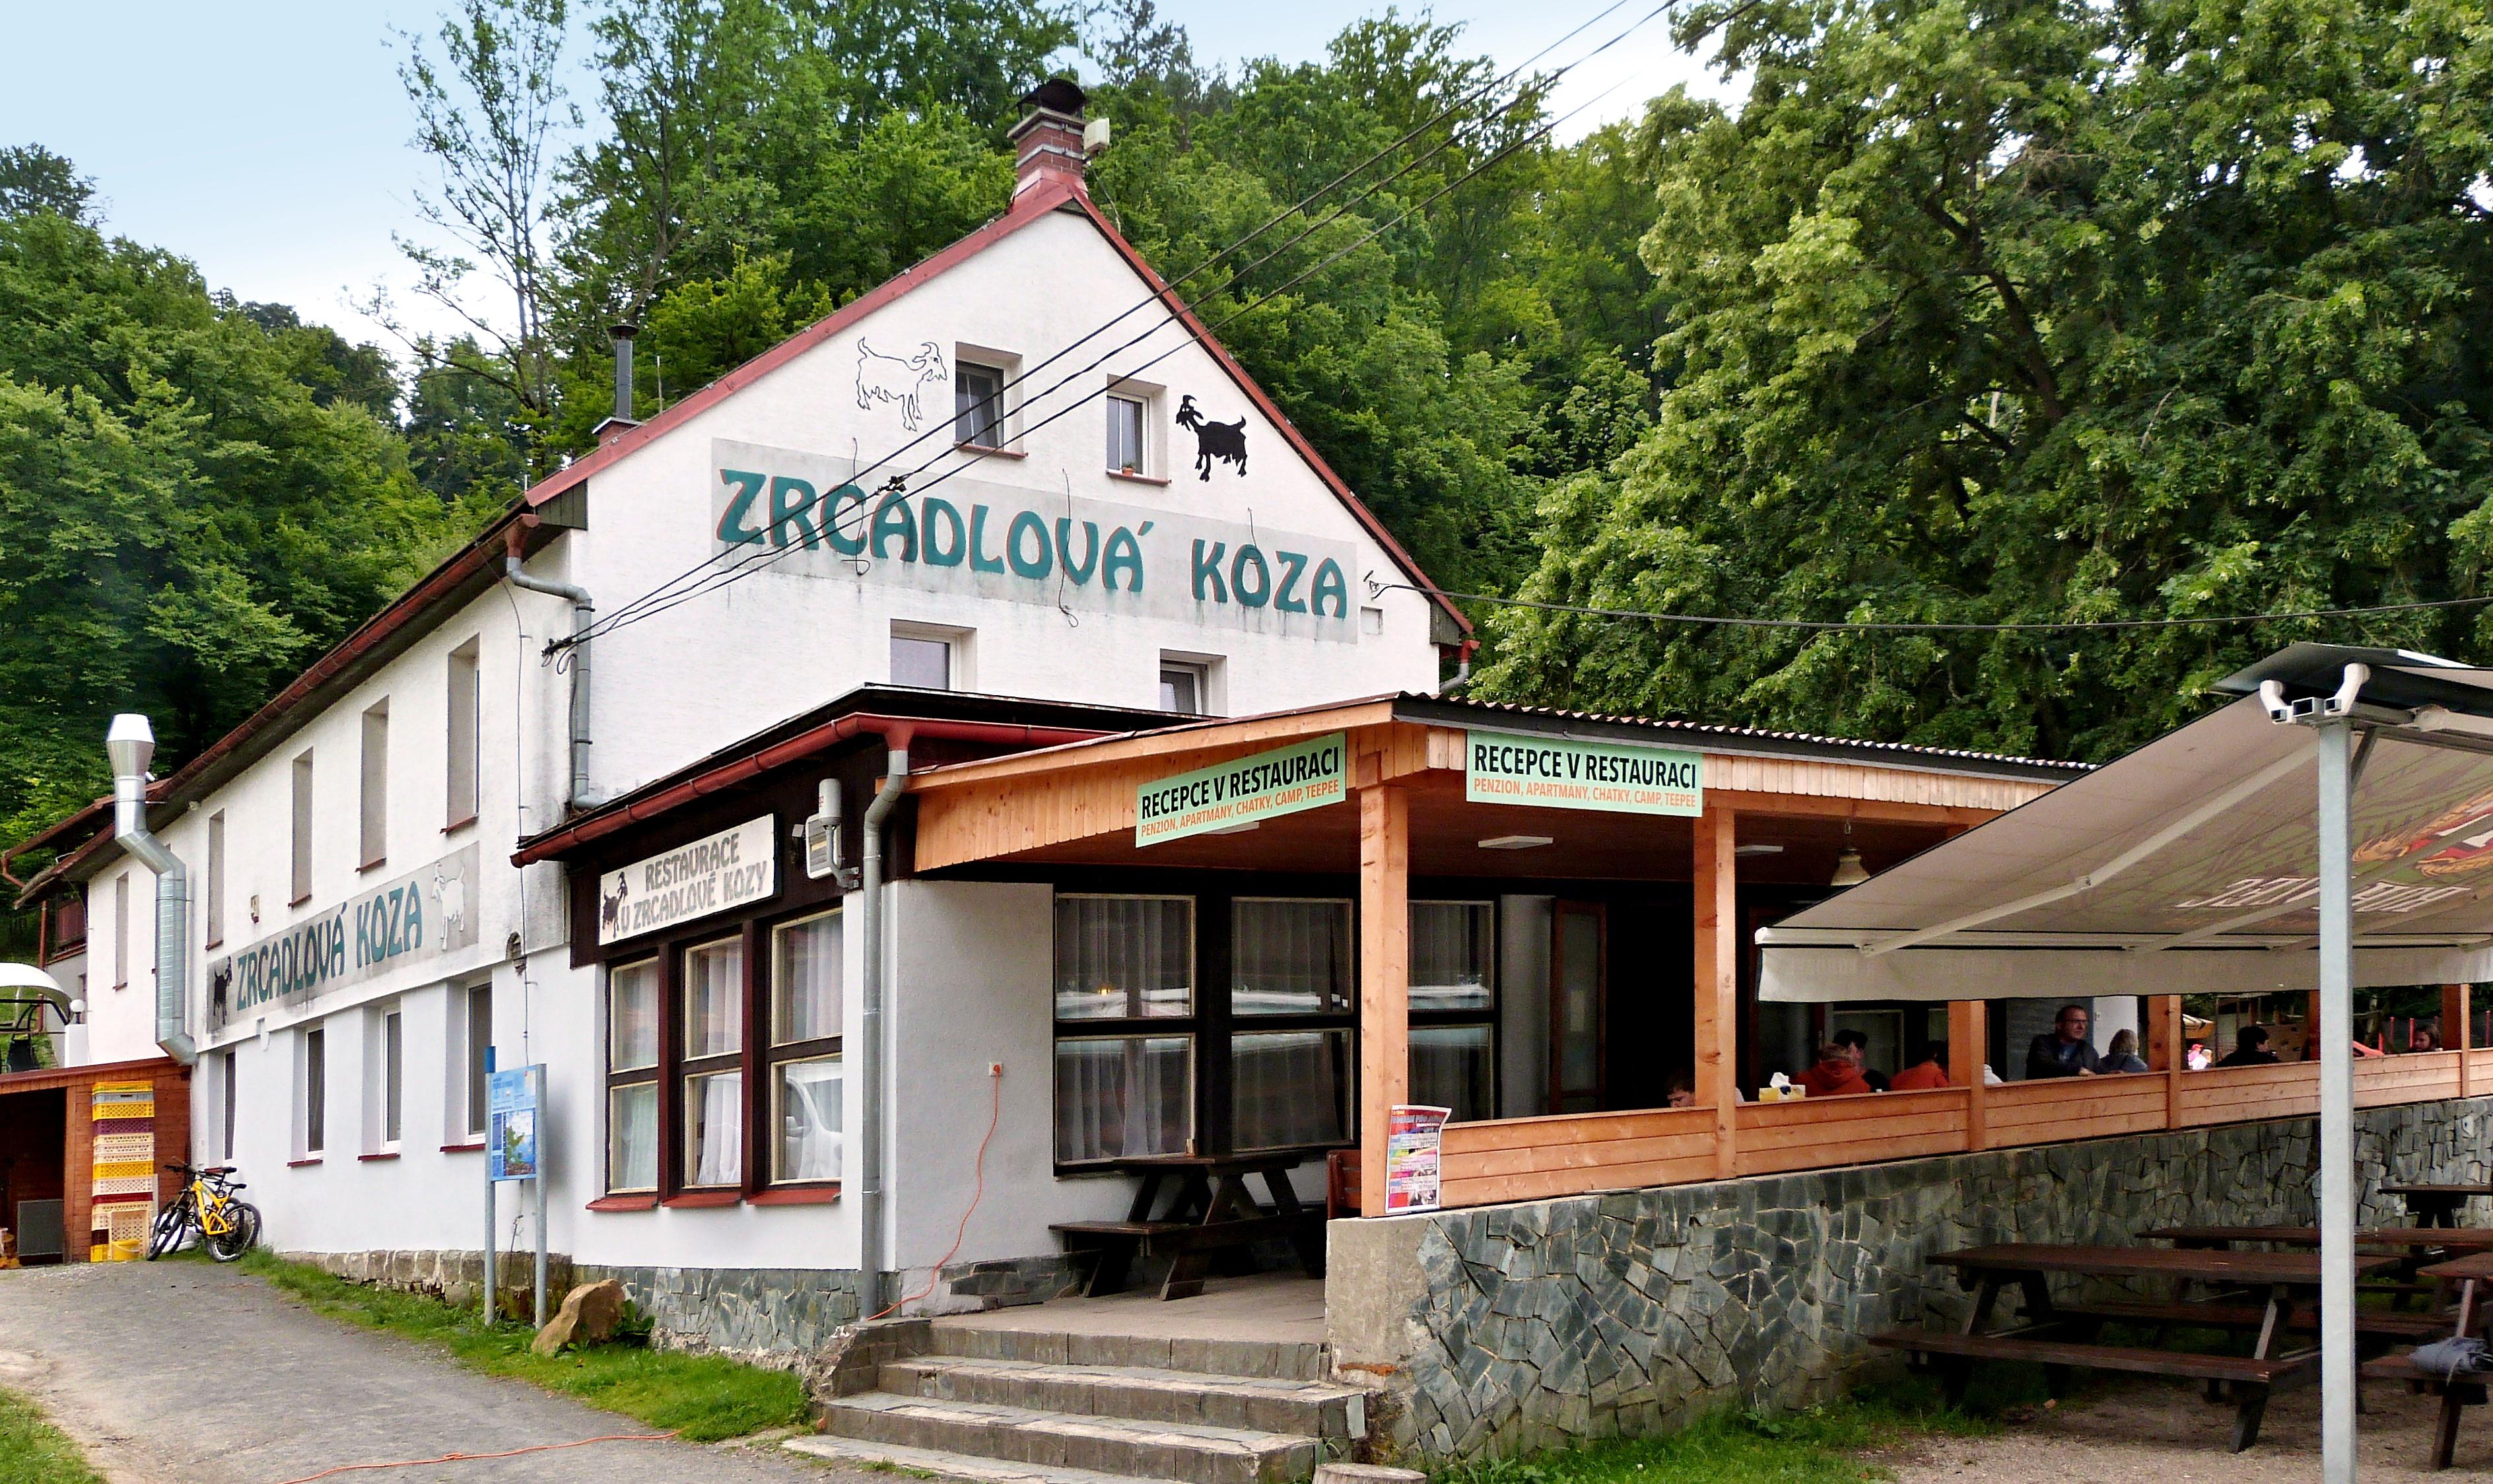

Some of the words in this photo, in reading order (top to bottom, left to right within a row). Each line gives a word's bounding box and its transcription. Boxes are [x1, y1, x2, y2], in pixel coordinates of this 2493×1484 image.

[717, 468, 1154, 594] ZRCADLOVÁ
[1192, 537, 1348, 619] KOZA
[1142, 780, 1210, 819] RECEPCE
[1213, 775, 1225, 801] V
[1230, 746, 1340, 799] RESTAURACI
[1474, 744, 1561, 778] RECEPCE
[1567, 753, 1581, 779] V
[1586, 755, 1697, 790] RESTAURACI
[1474, 778, 1523, 796] PENZION,
[1526, 782, 1590, 801] APARTMÁNY,
[1592, 787, 1632, 805] CHATKY,
[1634, 790, 1662, 807] CAMP,
[1665, 792, 1696, 808] TEEPEE
[1141, 817, 1178, 838] PENZION,
[1180, 803, 1235, 828] APARTMÁNY,
[1236, 795, 1274, 816] CHATKY,
[1275, 788, 1304, 807] CAMP,
[1305, 779, 1339, 800] TEEPEE
[645, 832, 741, 893] RESTAURACE
[621, 906, 630, 933] U
[633, 871, 716, 931] ZRCADLOVÉ
[724, 860, 768, 903] KOZY
[236, 902, 348, 1011] ZRCADLOVÁ
[356, 881, 423, 969] KOZA
